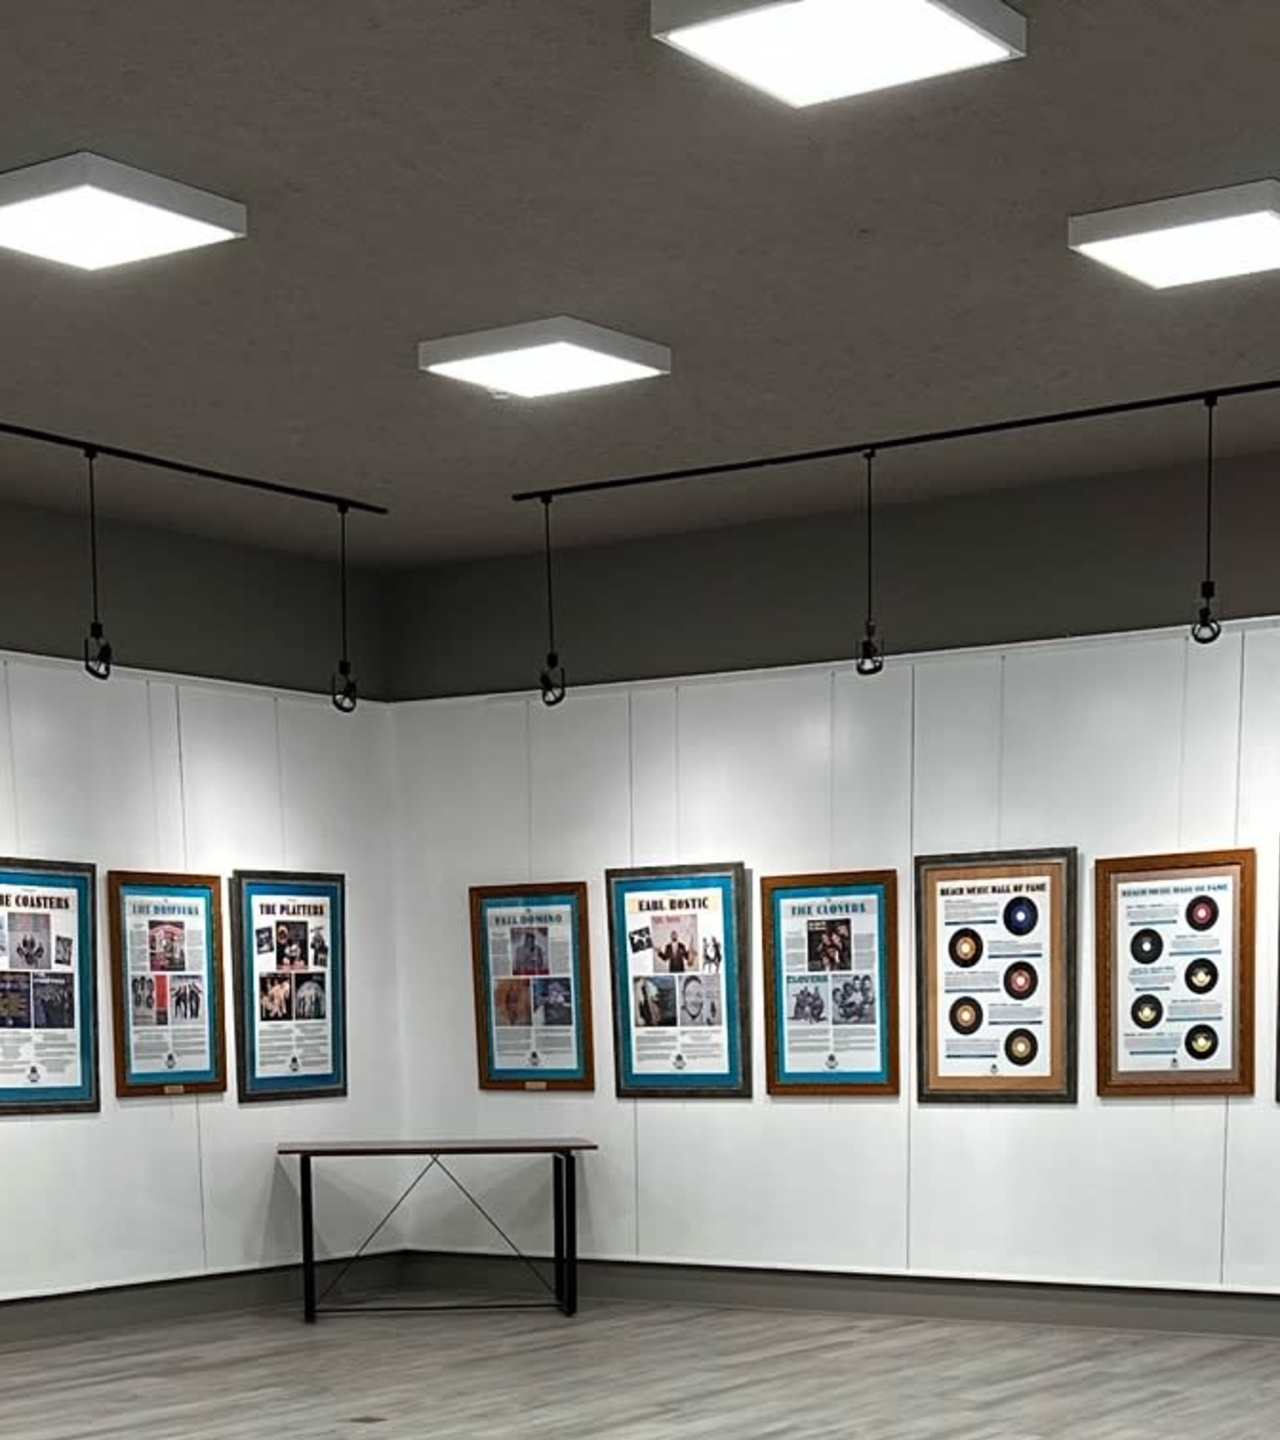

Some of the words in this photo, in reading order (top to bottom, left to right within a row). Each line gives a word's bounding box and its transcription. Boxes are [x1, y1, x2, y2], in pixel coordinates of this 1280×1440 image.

[940, 887, 964, 897] BEACH
[991, 884, 1010, 894] HALL
[1013, 883, 1023, 893] OF
[1026, 882, 1046, 892] FAME
[15, 894, 70, 910] COASTERS
[259, 903, 276, 916] THE
[280, 903, 325, 916] PLATTERS
[638, 898, 665, 912] EARL
[669, 896, 709, 911] BOSTIC
[791, 904, 813, 916] THE
[816, 902, 866, 915] CLOVERS
